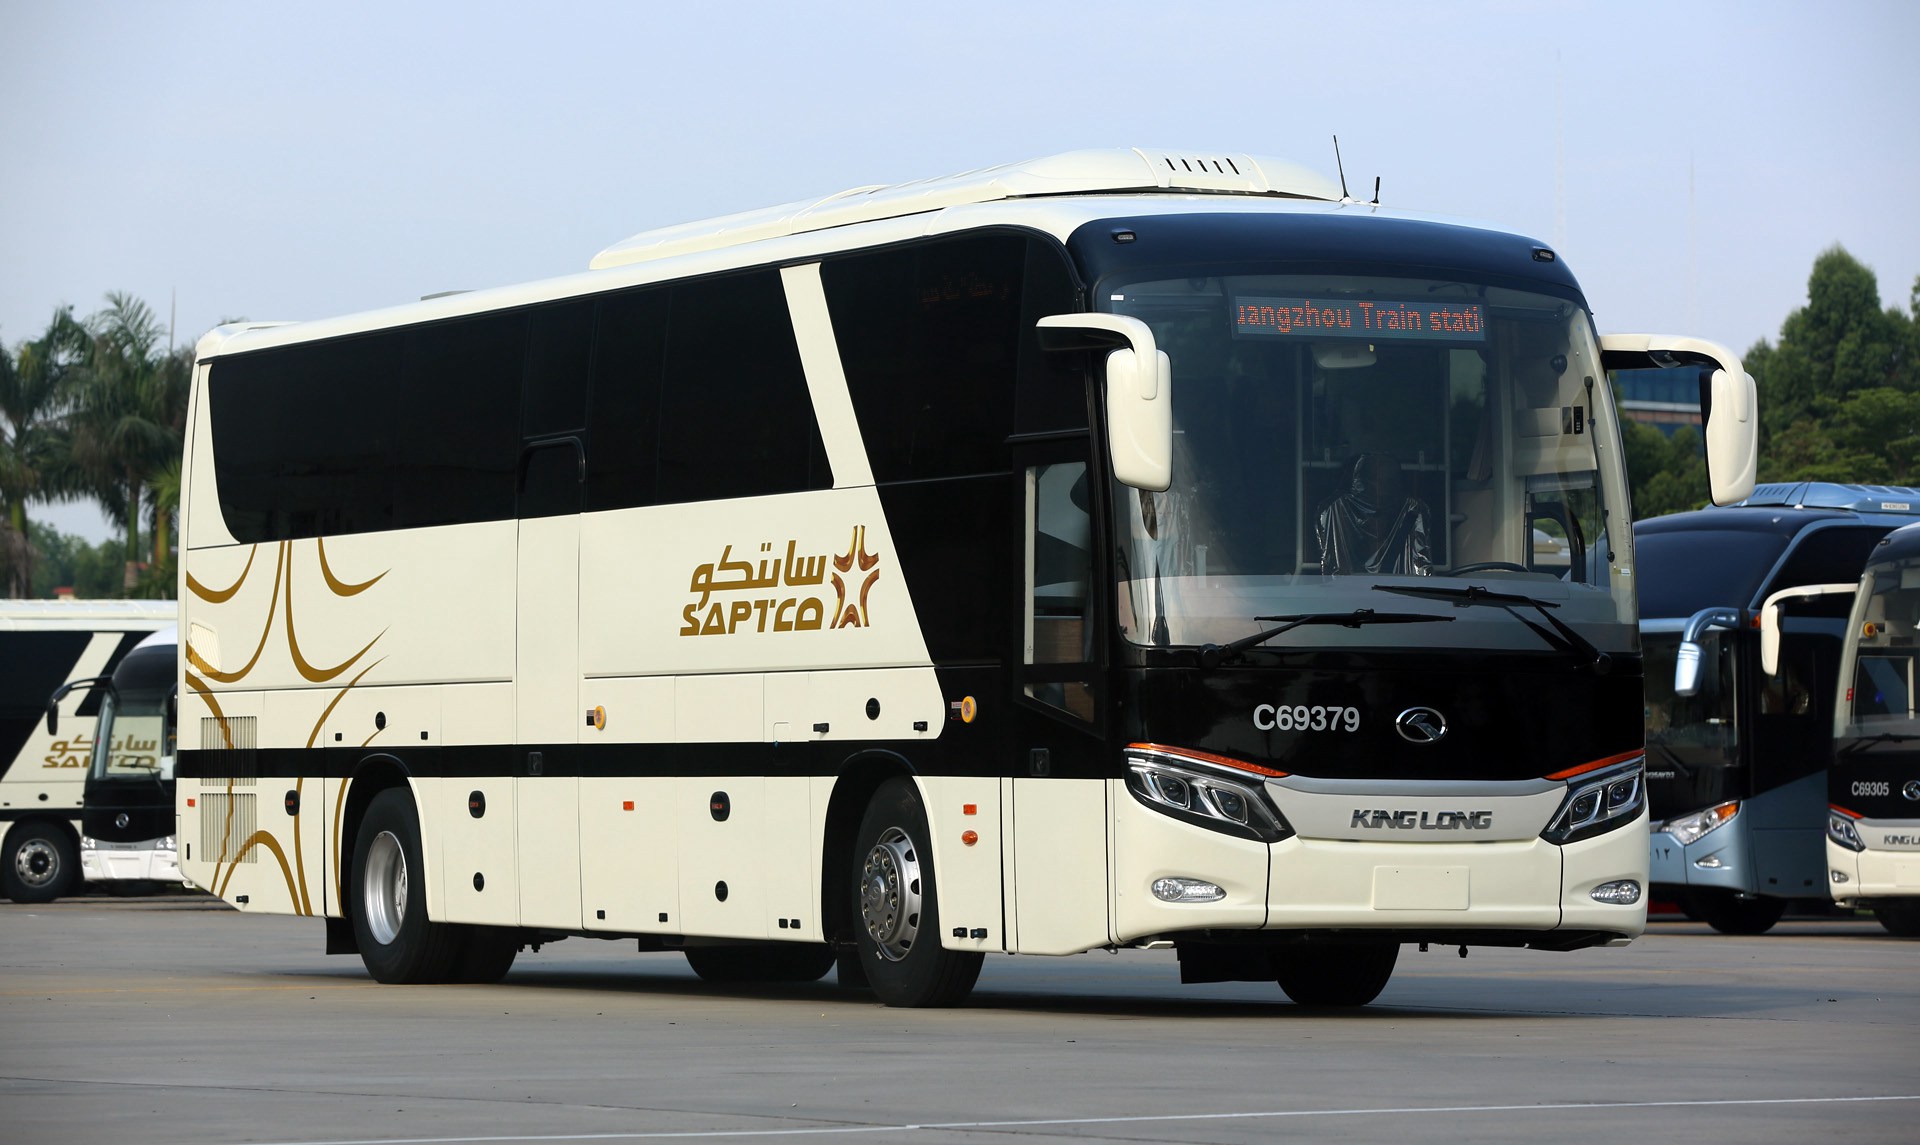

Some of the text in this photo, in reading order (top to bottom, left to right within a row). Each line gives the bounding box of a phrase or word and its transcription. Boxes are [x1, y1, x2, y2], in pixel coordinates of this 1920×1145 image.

[1359, 302, 1421, 330] Train
[1429, 306, 1483, 332] stati
[679, 597, 824, 637] SAPTCO
[1253, 704, 1360, 732] C69379
[1851, 781, 1889, 796] C69305
[1350, 809, 1492, 830] KING LONG
[1883, 835, 1920, 845] KING L
